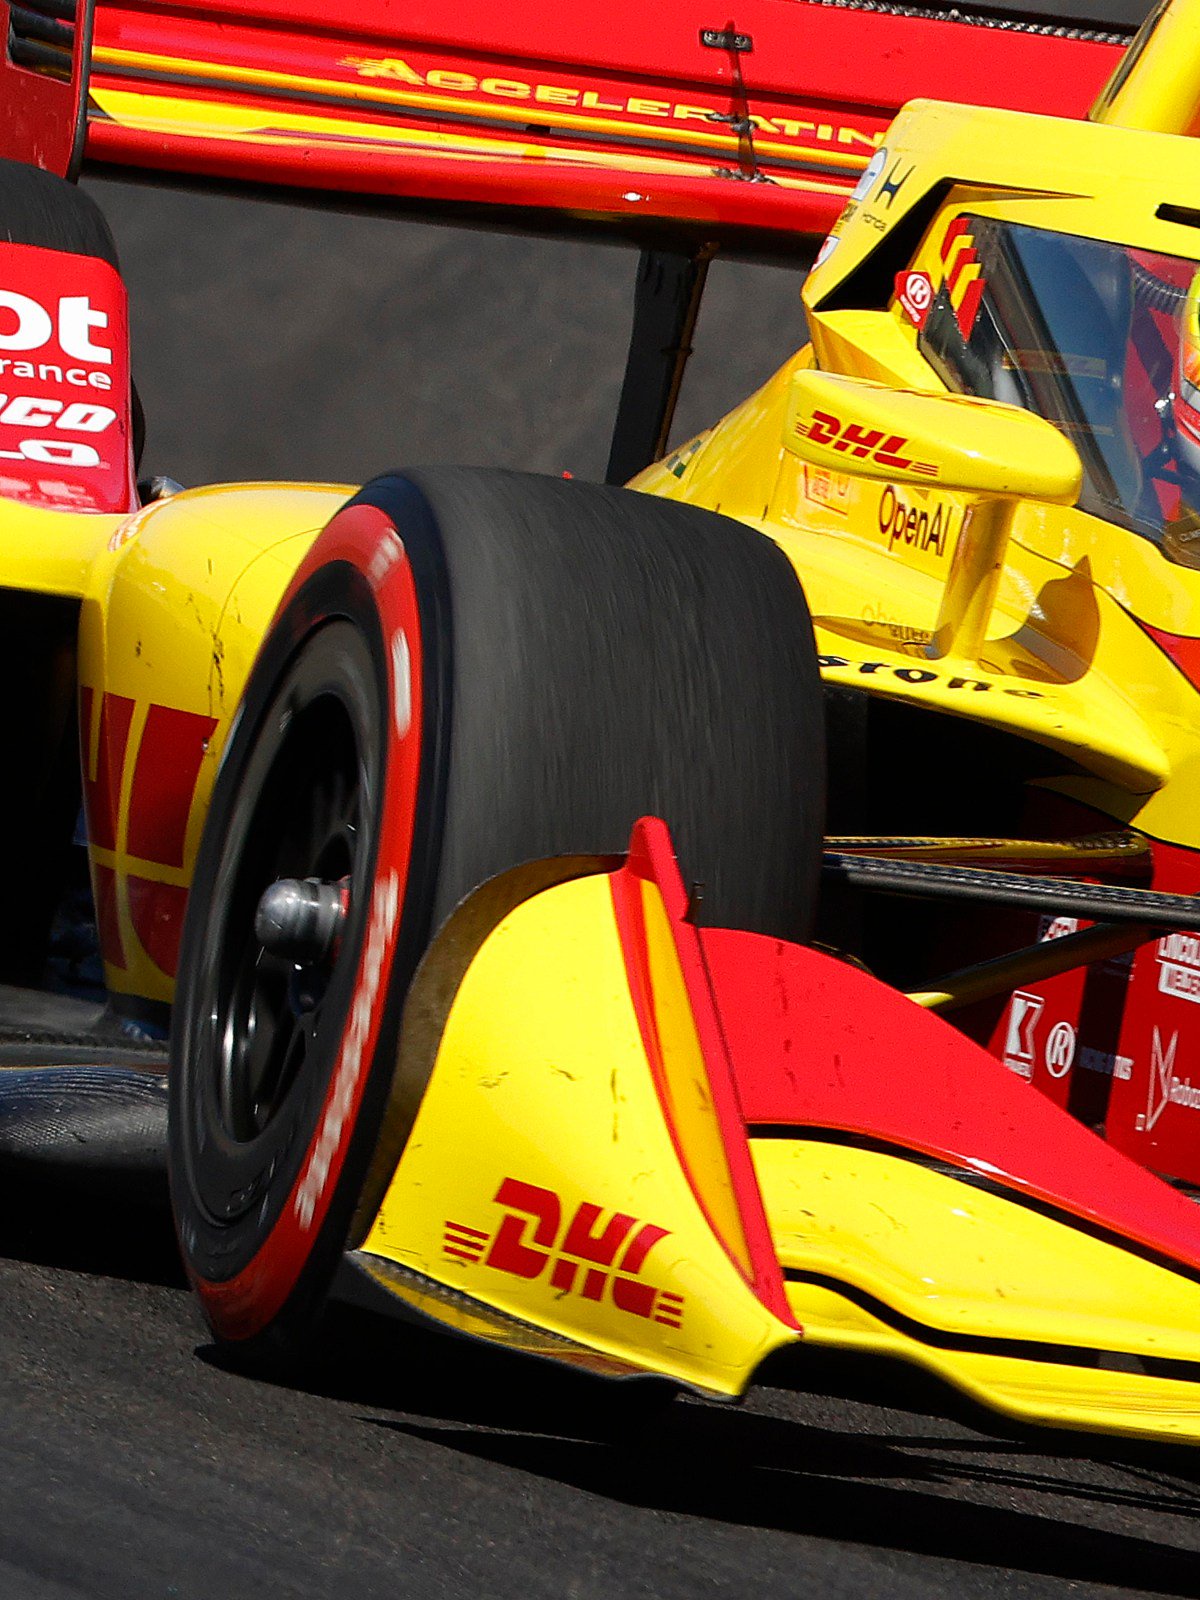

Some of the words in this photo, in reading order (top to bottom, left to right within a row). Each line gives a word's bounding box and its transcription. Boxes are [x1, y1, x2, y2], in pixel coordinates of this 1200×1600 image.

[804, 409, 916, 470] DHL
[877, 484, 953, 558] OpenAI
[482, 1177, 676, 1319] DHL
